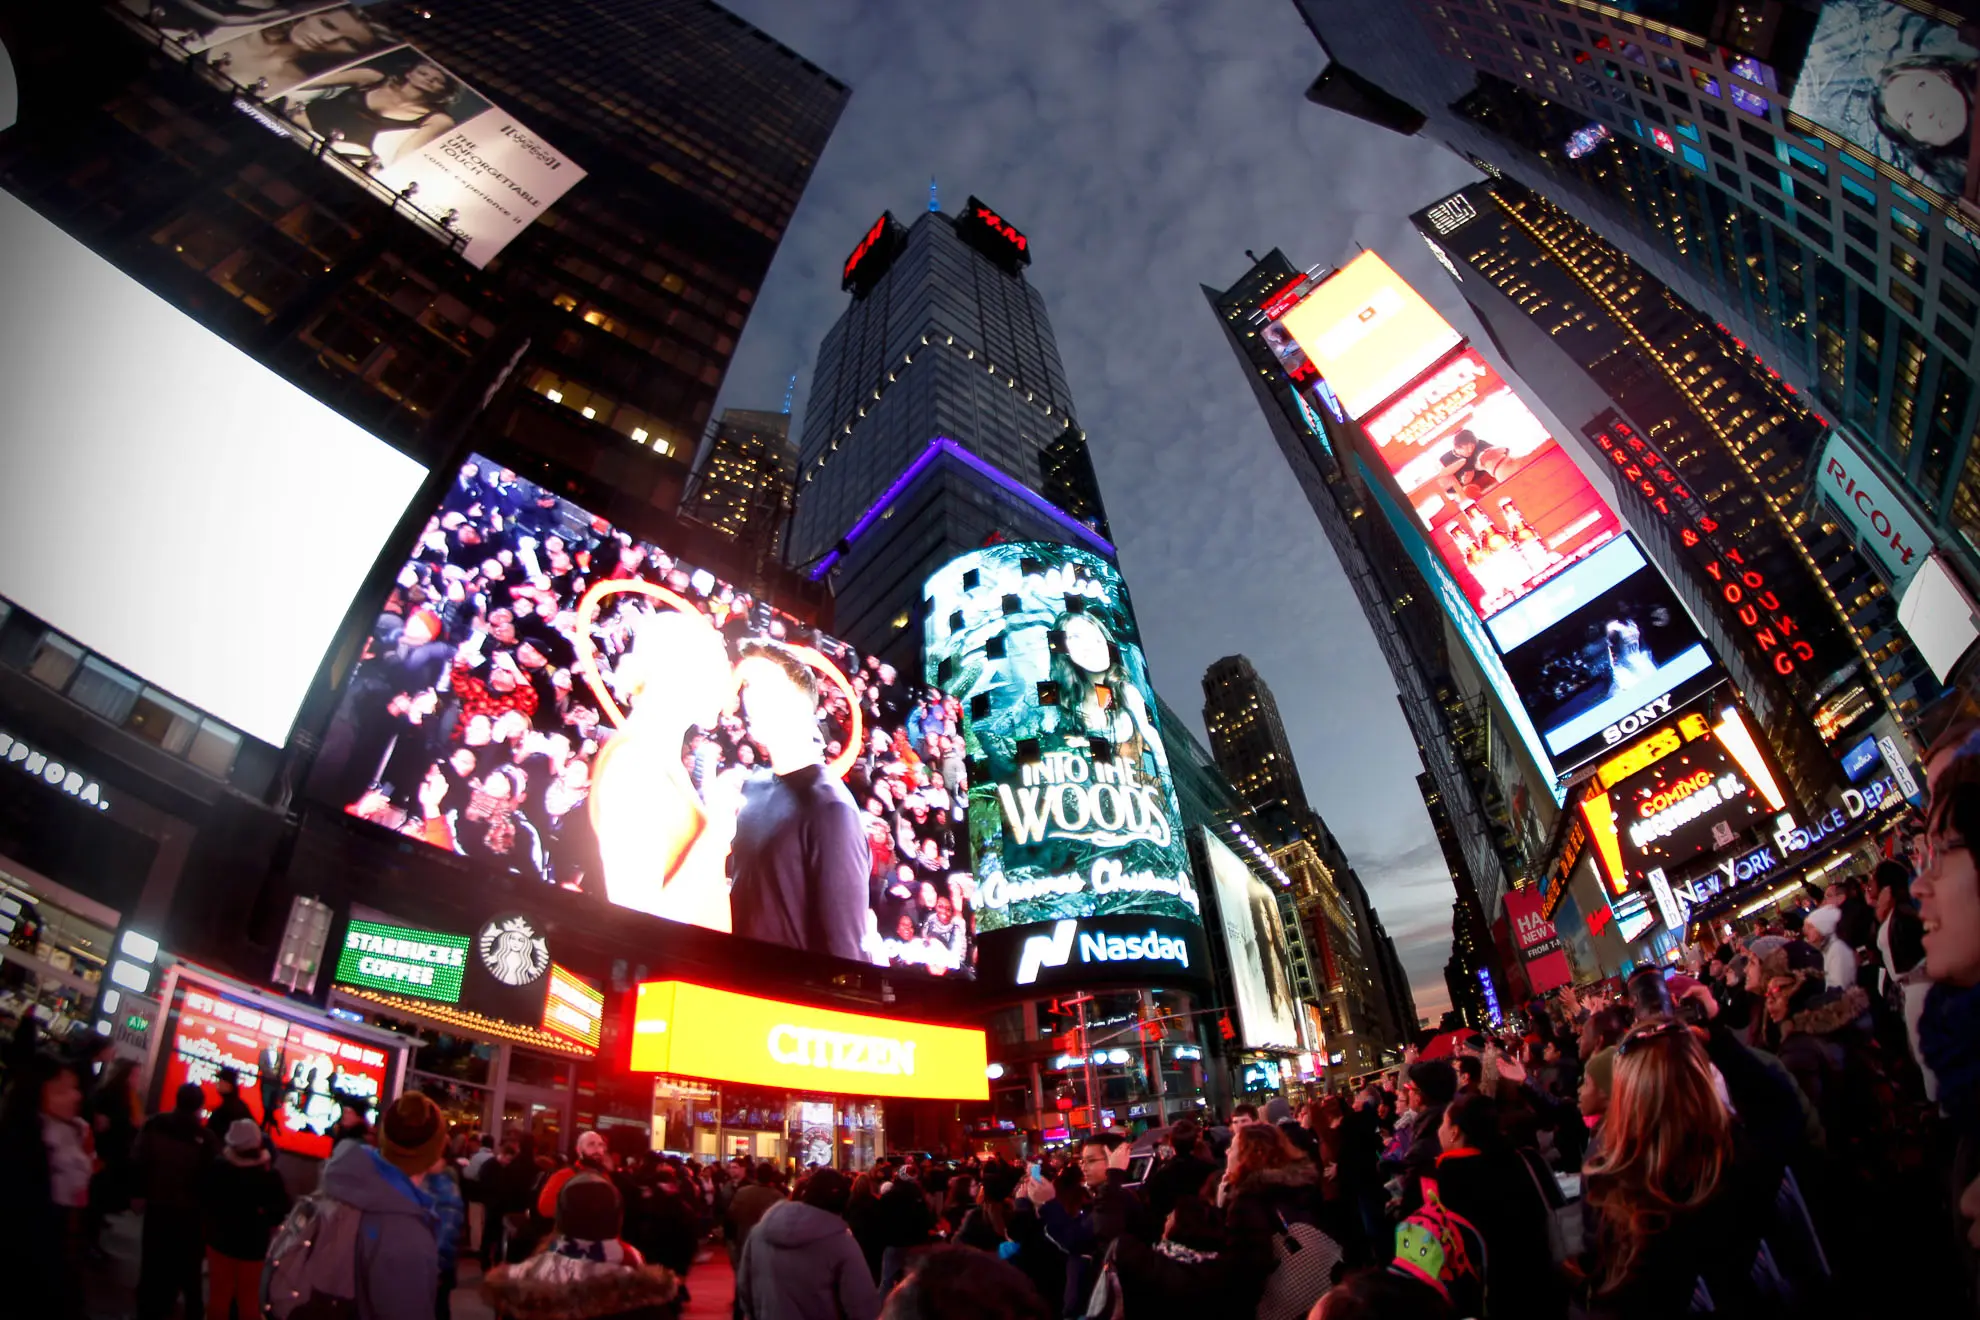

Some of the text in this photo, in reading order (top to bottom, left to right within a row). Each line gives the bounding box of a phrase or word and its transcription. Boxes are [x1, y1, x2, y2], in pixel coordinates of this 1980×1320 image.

[439, 144, 483, 176] TOUCH
[455, 133, 478, 150] THE
[447, 138, 541, 207] UNFORGETTABLE
[455, 174, 511, 216] experience
[513, 214, 523, 225] it
[1827, 457, 1915, 565] RICOH
[1600, 434, 1794, 675] ERNST & YOUNG
[1602, 694, 1672, 745] SONY
[1022, 752, 1142, 788] INTO THE
[1881, 740, 1915, 794] NYPD
[997, 783, 1171, 847] WOODS
[1640, 771, 1710, 818] COMING
[1673, 879, 1722, 908] NEW
[1718, 848, 1776, 887] YORK
[1773, 808, 1846, 858] POLICE
[1517, 911, 1550, 932] HA
[1653, 871, 1680, 926] NYPD
[347, 931, 464, 967] STARBUCKS
[1080, 928, 1189, 968] Nasdaq
[1522, 926, 1550, 945] NEW
[1528, 945, 1550, 958] FROM
[359, 956, 434, 986] COFFEE
[767, 1024, 916, 1076] CITIZEN
